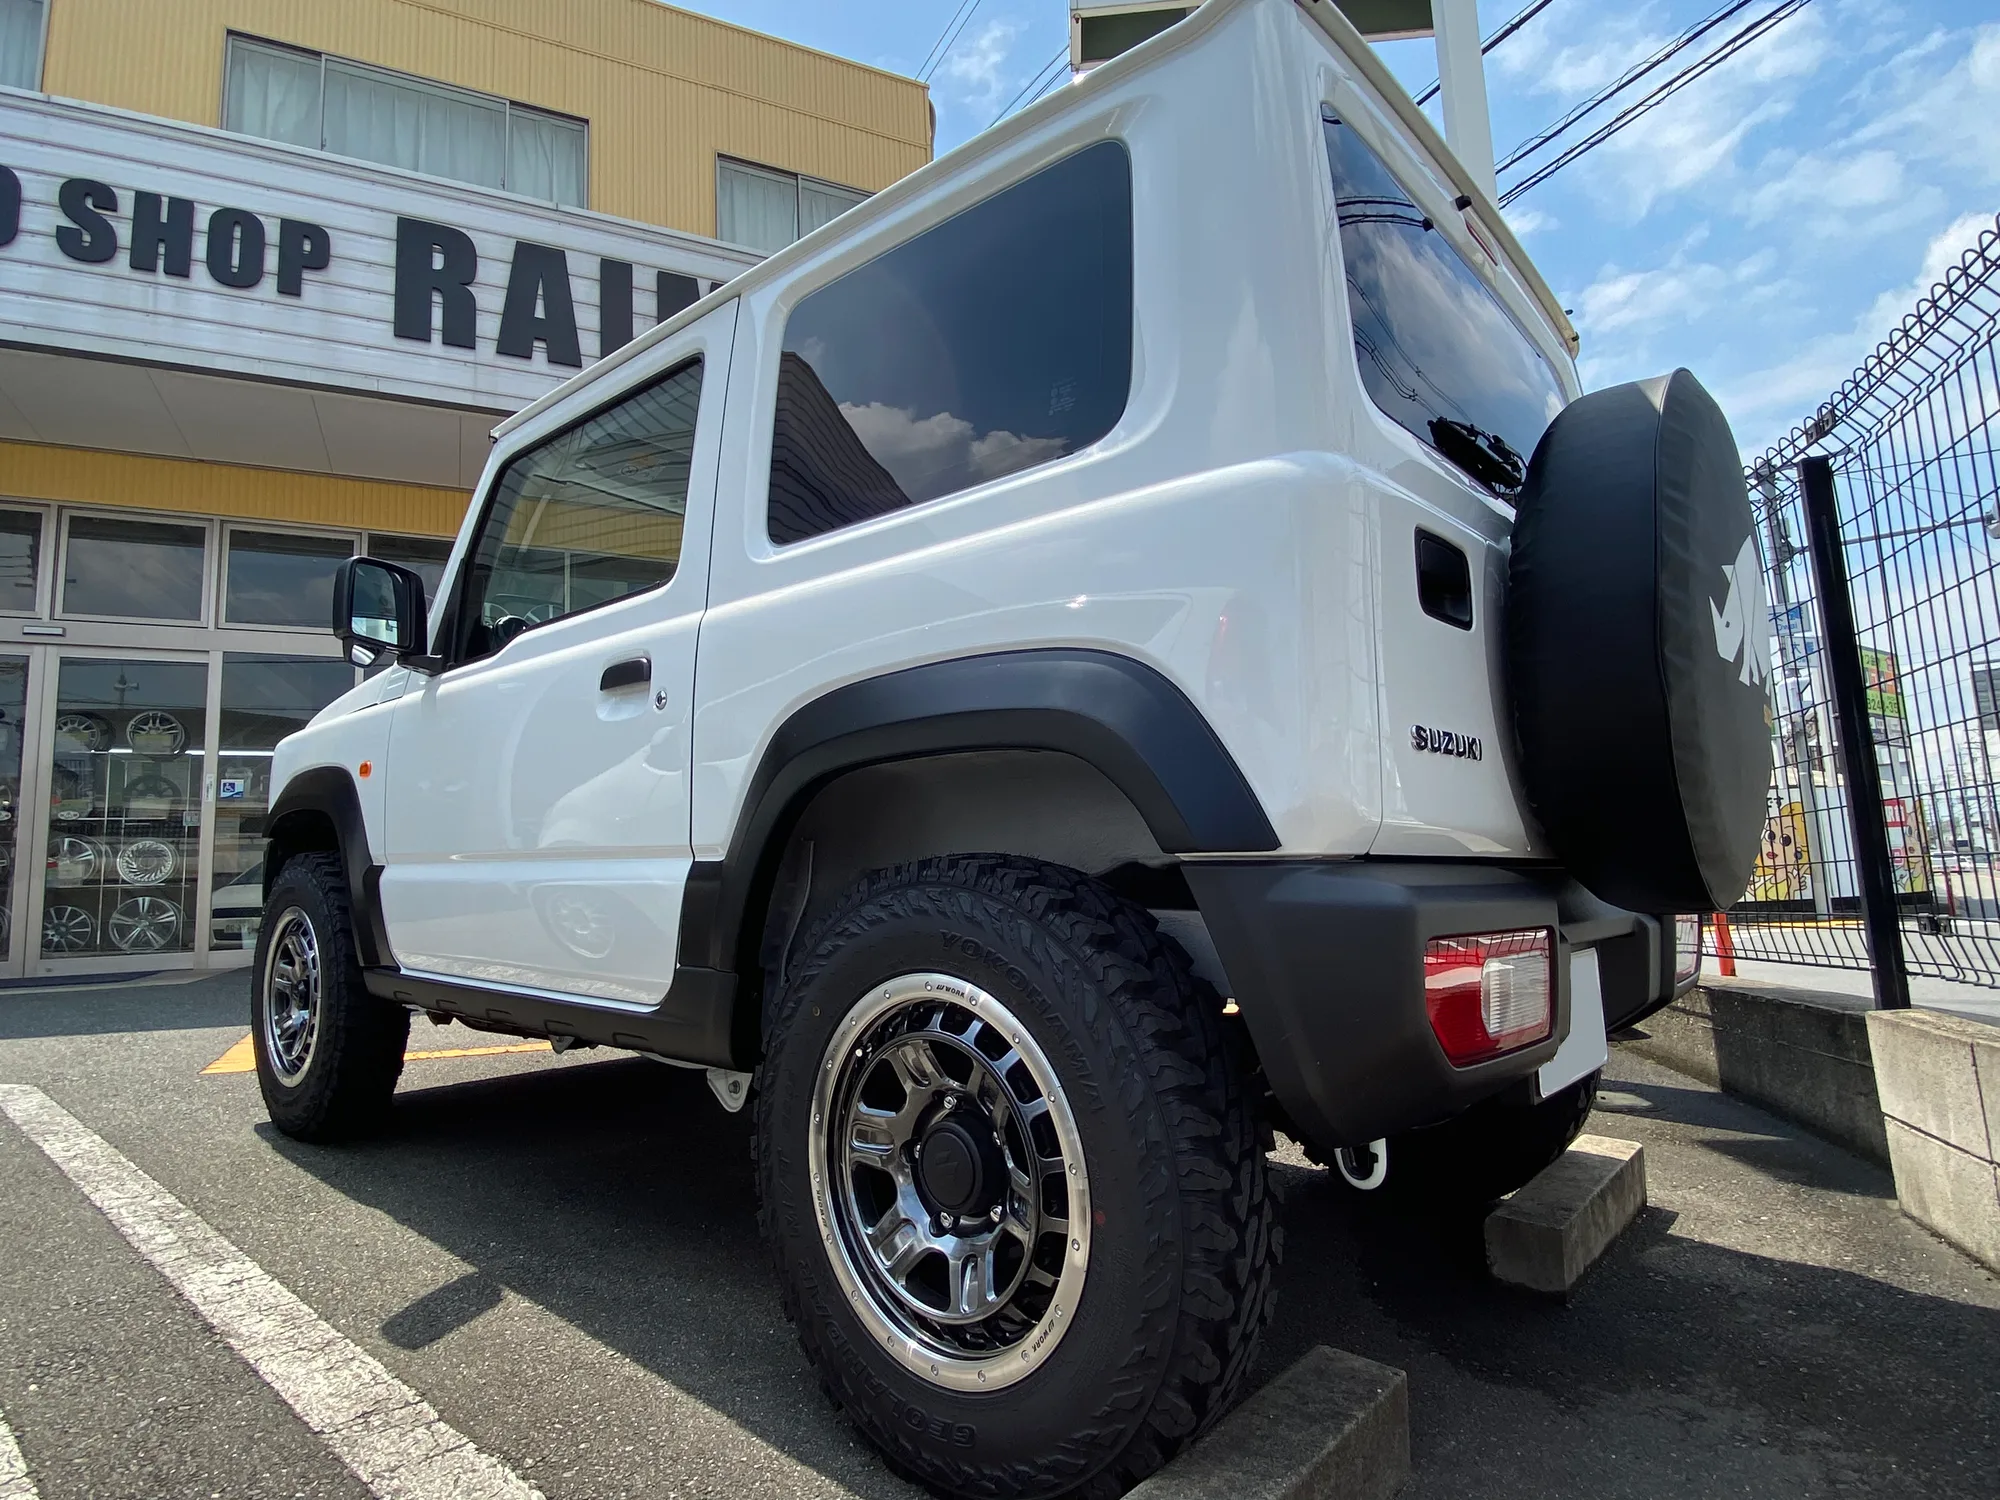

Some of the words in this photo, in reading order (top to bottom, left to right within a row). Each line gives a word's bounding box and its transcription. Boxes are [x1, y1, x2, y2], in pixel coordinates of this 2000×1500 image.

[56, 177, 330, 297] SHOP
[1410, 724, 1482, 761] SUZUKI
[938, 928, 1106, 1113] YOKOHAMA
